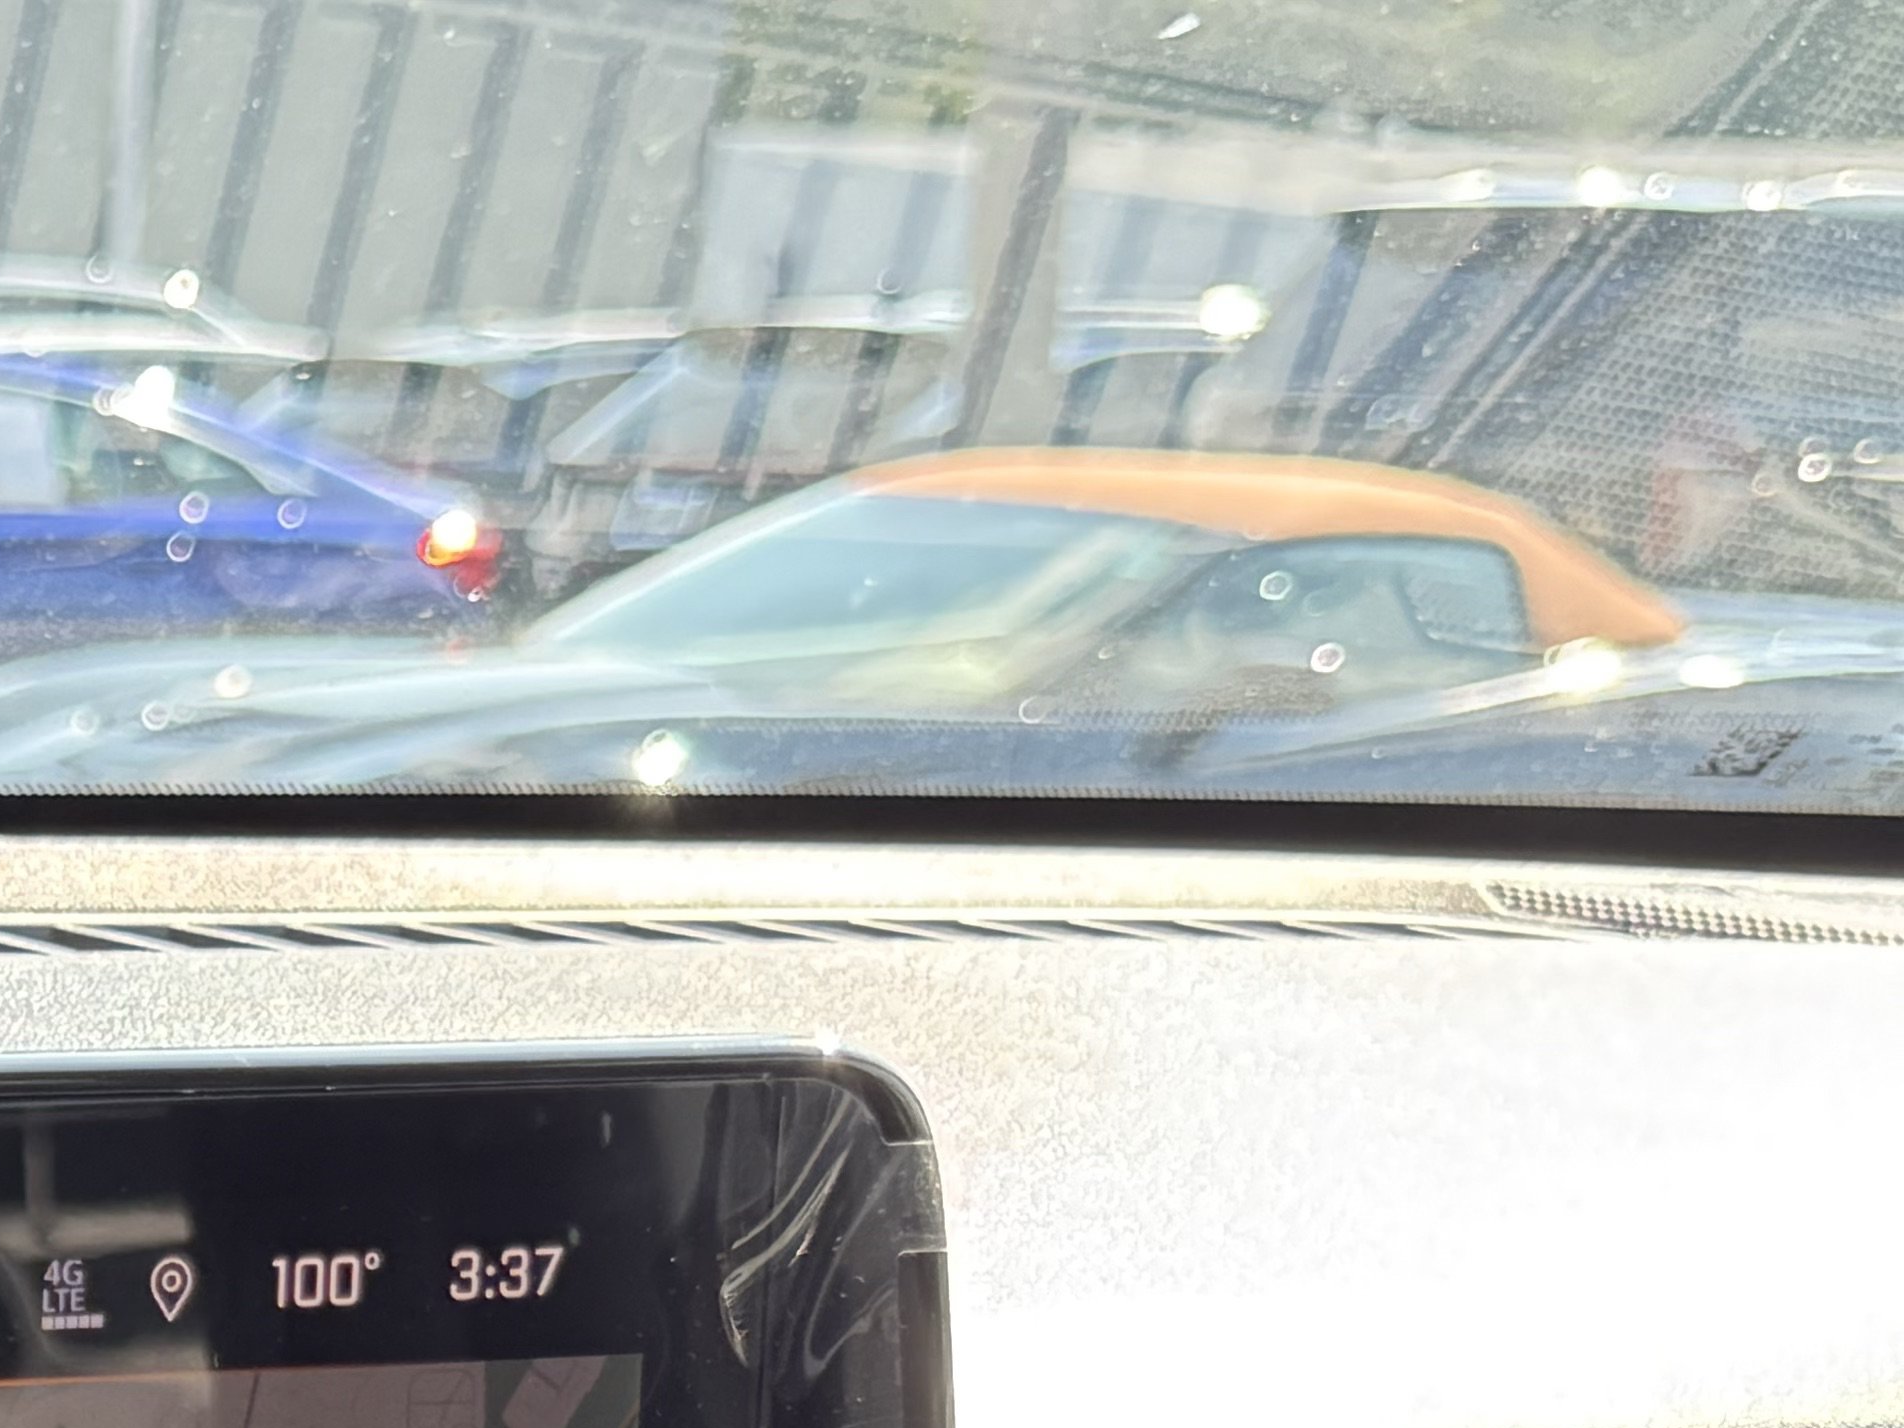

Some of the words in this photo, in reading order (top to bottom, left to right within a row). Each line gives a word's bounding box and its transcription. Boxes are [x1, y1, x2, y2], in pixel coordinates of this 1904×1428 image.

[42, 1258, 84, 1285] 4G
[271, 1252, 381, 1309] 100°
[448, 1246, 565, 1301] 3:37
[42, 1286, 86, 1313] LTE
